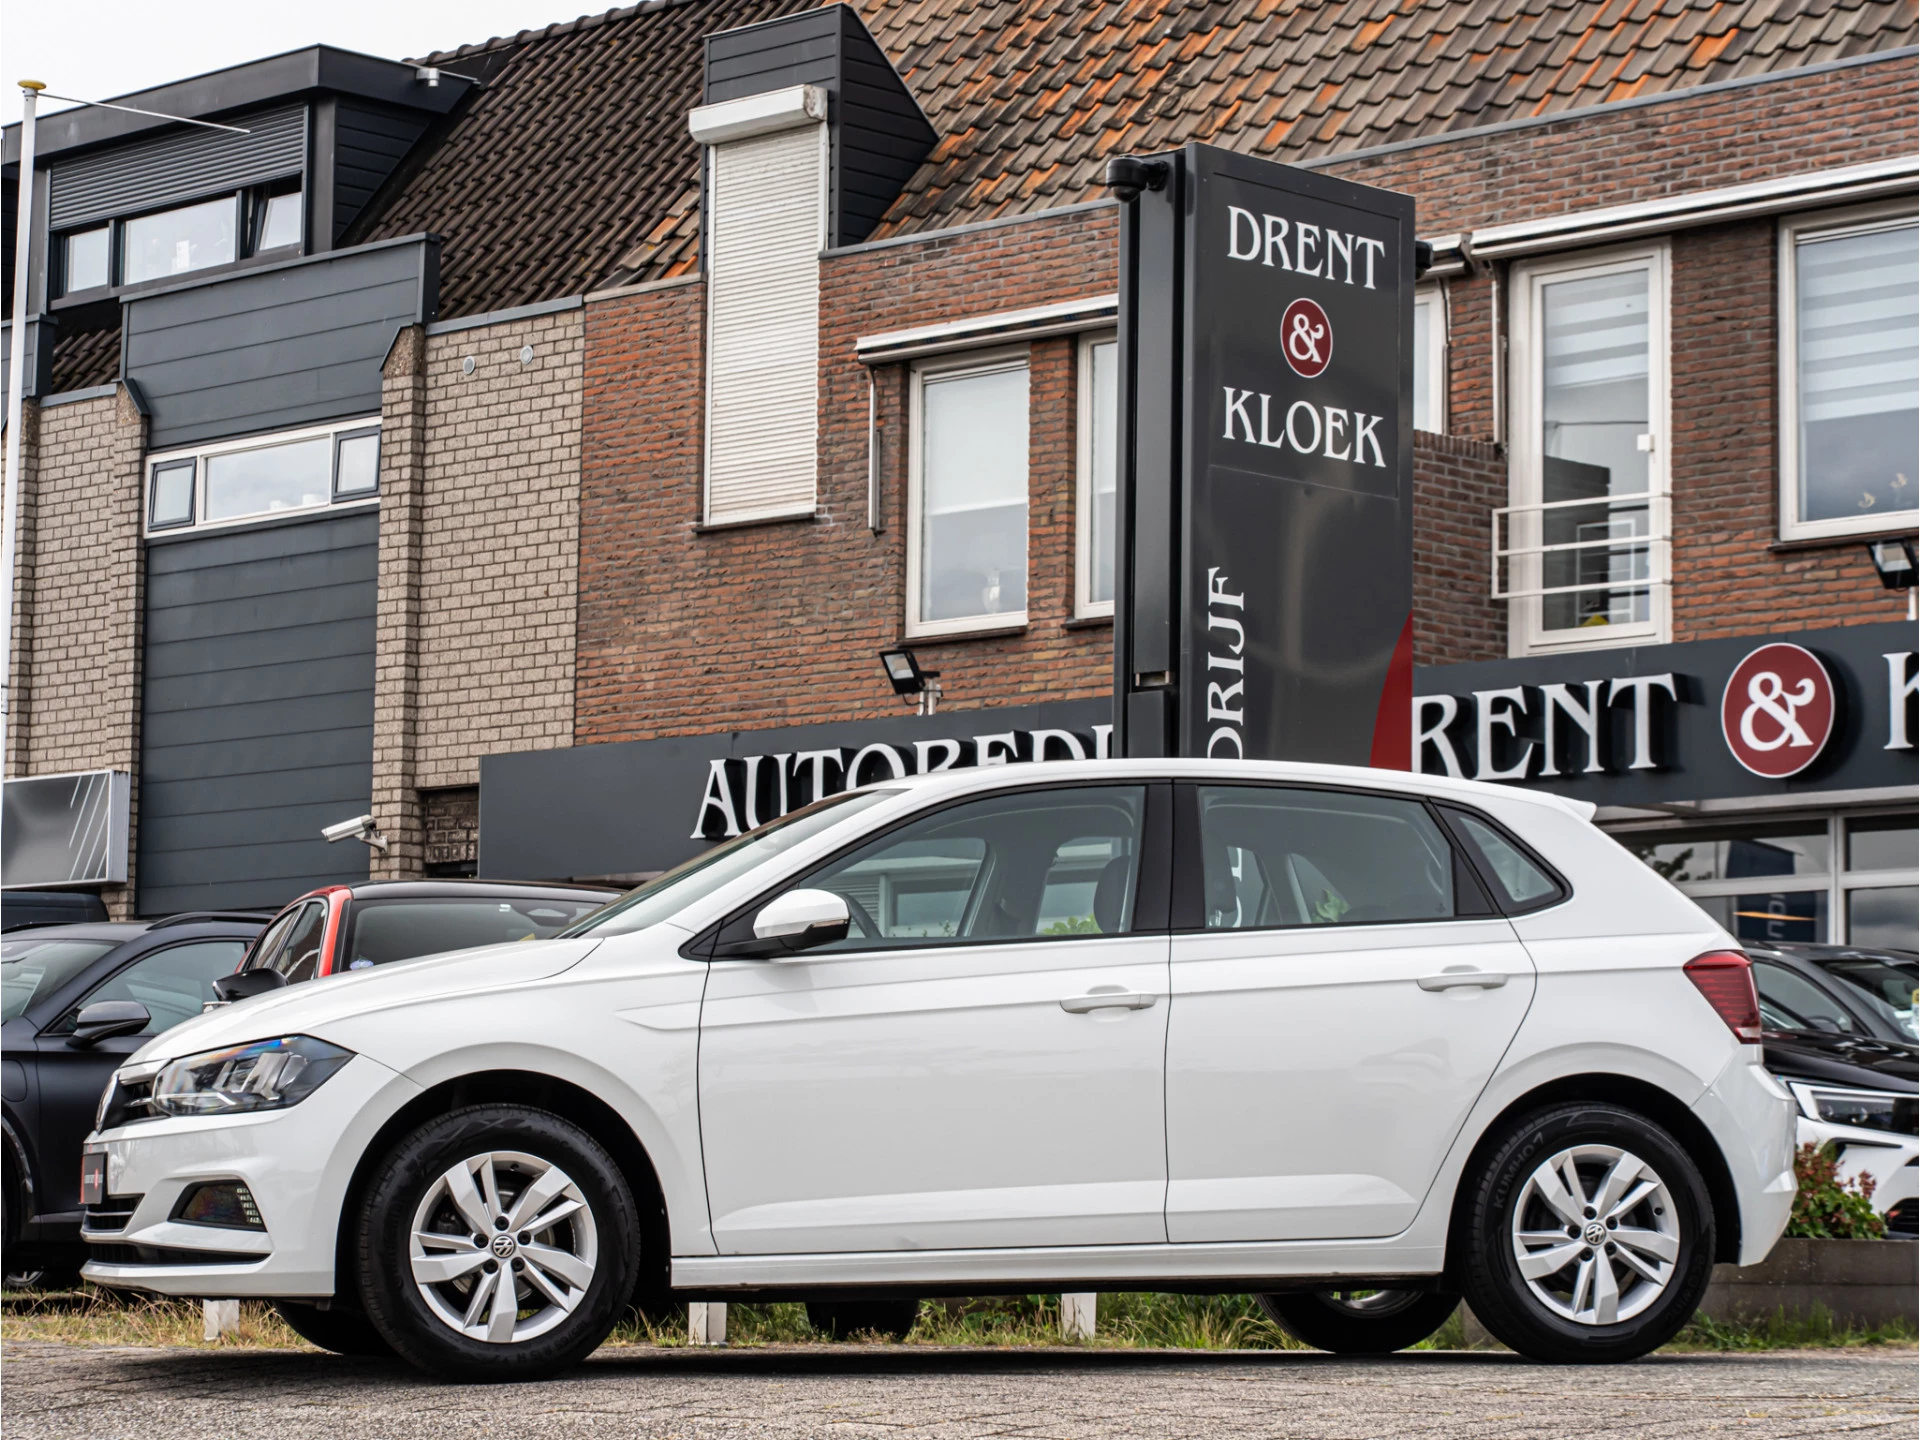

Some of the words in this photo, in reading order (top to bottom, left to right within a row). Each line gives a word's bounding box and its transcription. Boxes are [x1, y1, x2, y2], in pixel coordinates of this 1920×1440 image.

[1227, 205, 1385, 290] DRENT
[1289, 313, 1324, 363] &
[1222, 386, 1387, 468] KLOEK
[1740, 671, 1816, 752] &
